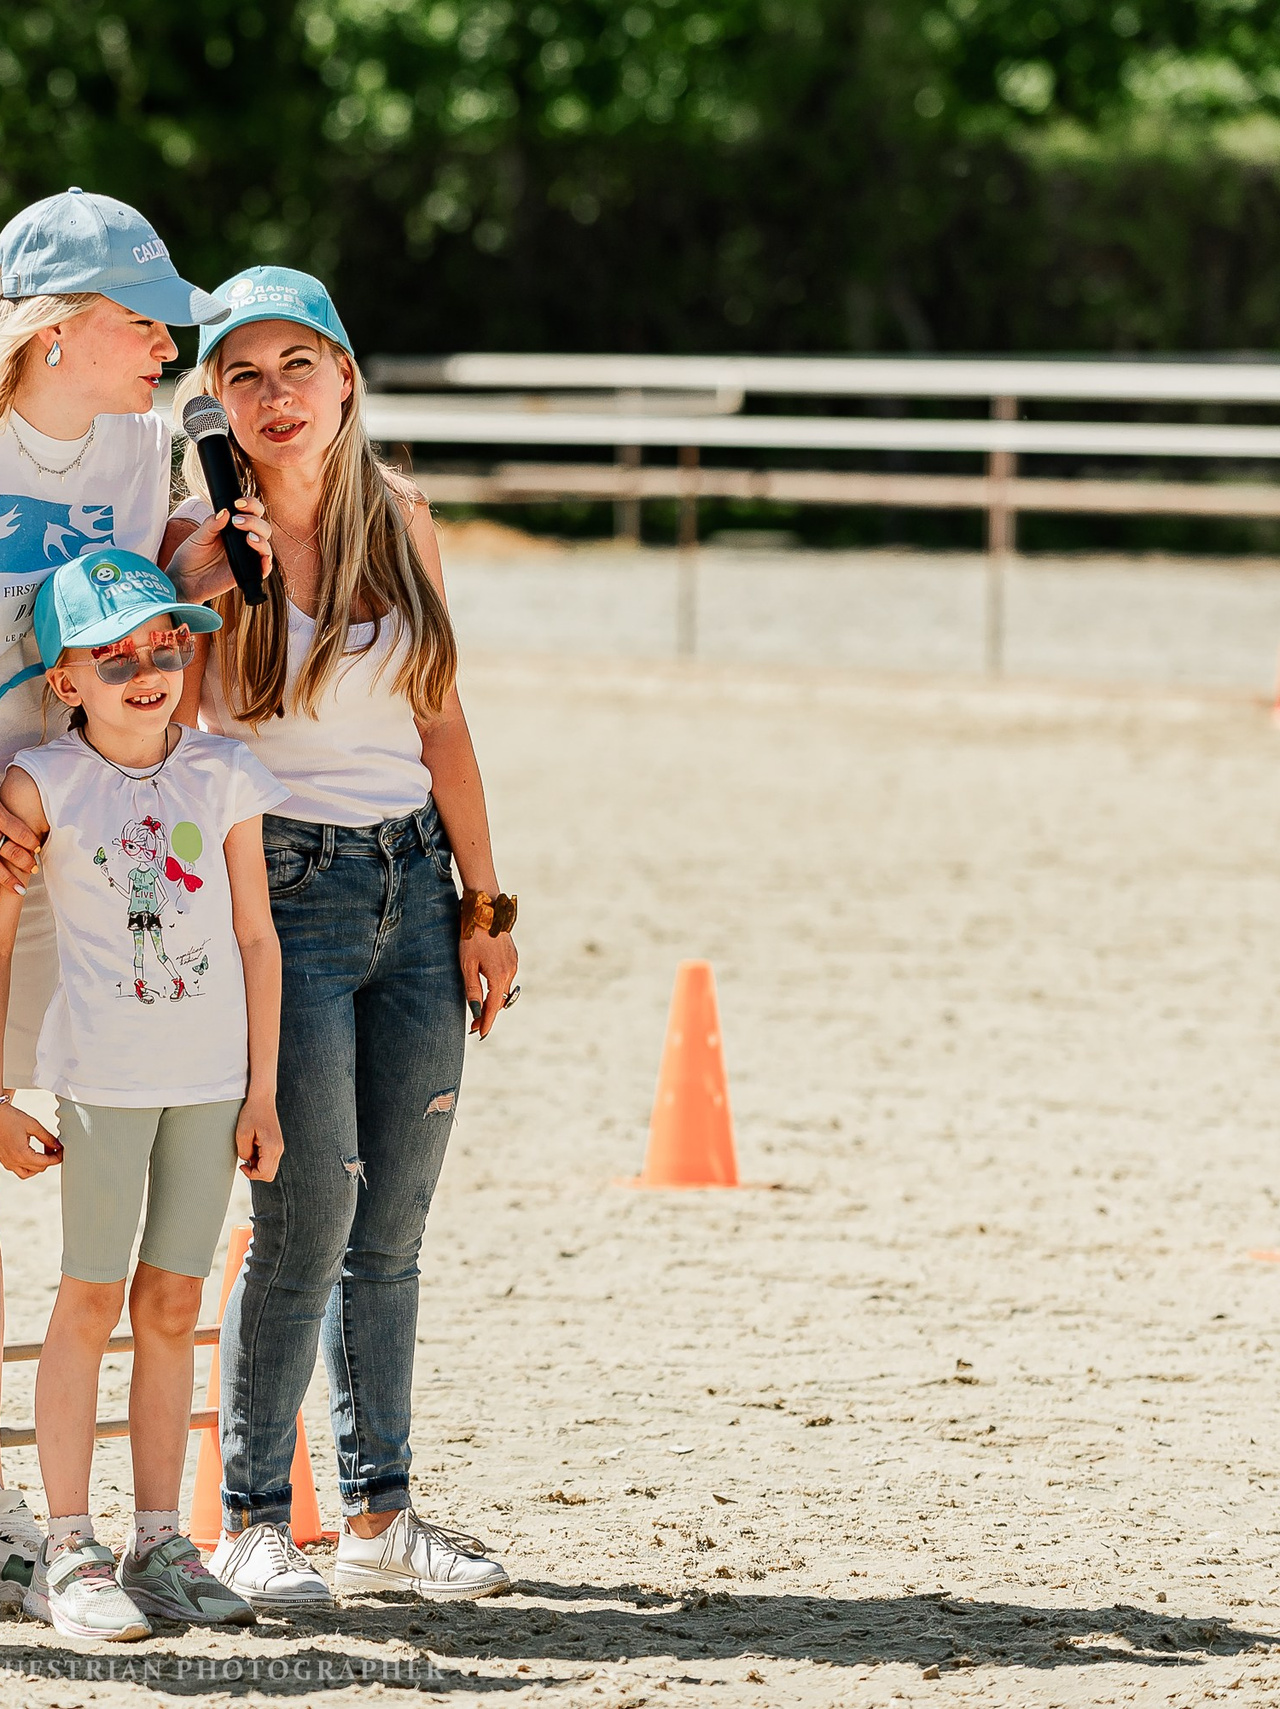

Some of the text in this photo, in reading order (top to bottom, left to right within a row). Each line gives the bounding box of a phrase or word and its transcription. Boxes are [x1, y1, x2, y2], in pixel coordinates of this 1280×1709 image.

[254, 285, 298, 295] ДАРЮ
[231, 293, 305, 310] ЛЮБОВЬ
[124, 570, 160, 583] ДАРЮ
[3, 583, 38, 598] FIRST
[104, 579, 171, 600] ЛЮБОВЬ
[5, 635, 16, 643] LE
[135, 890, 154, 899] LIVE
